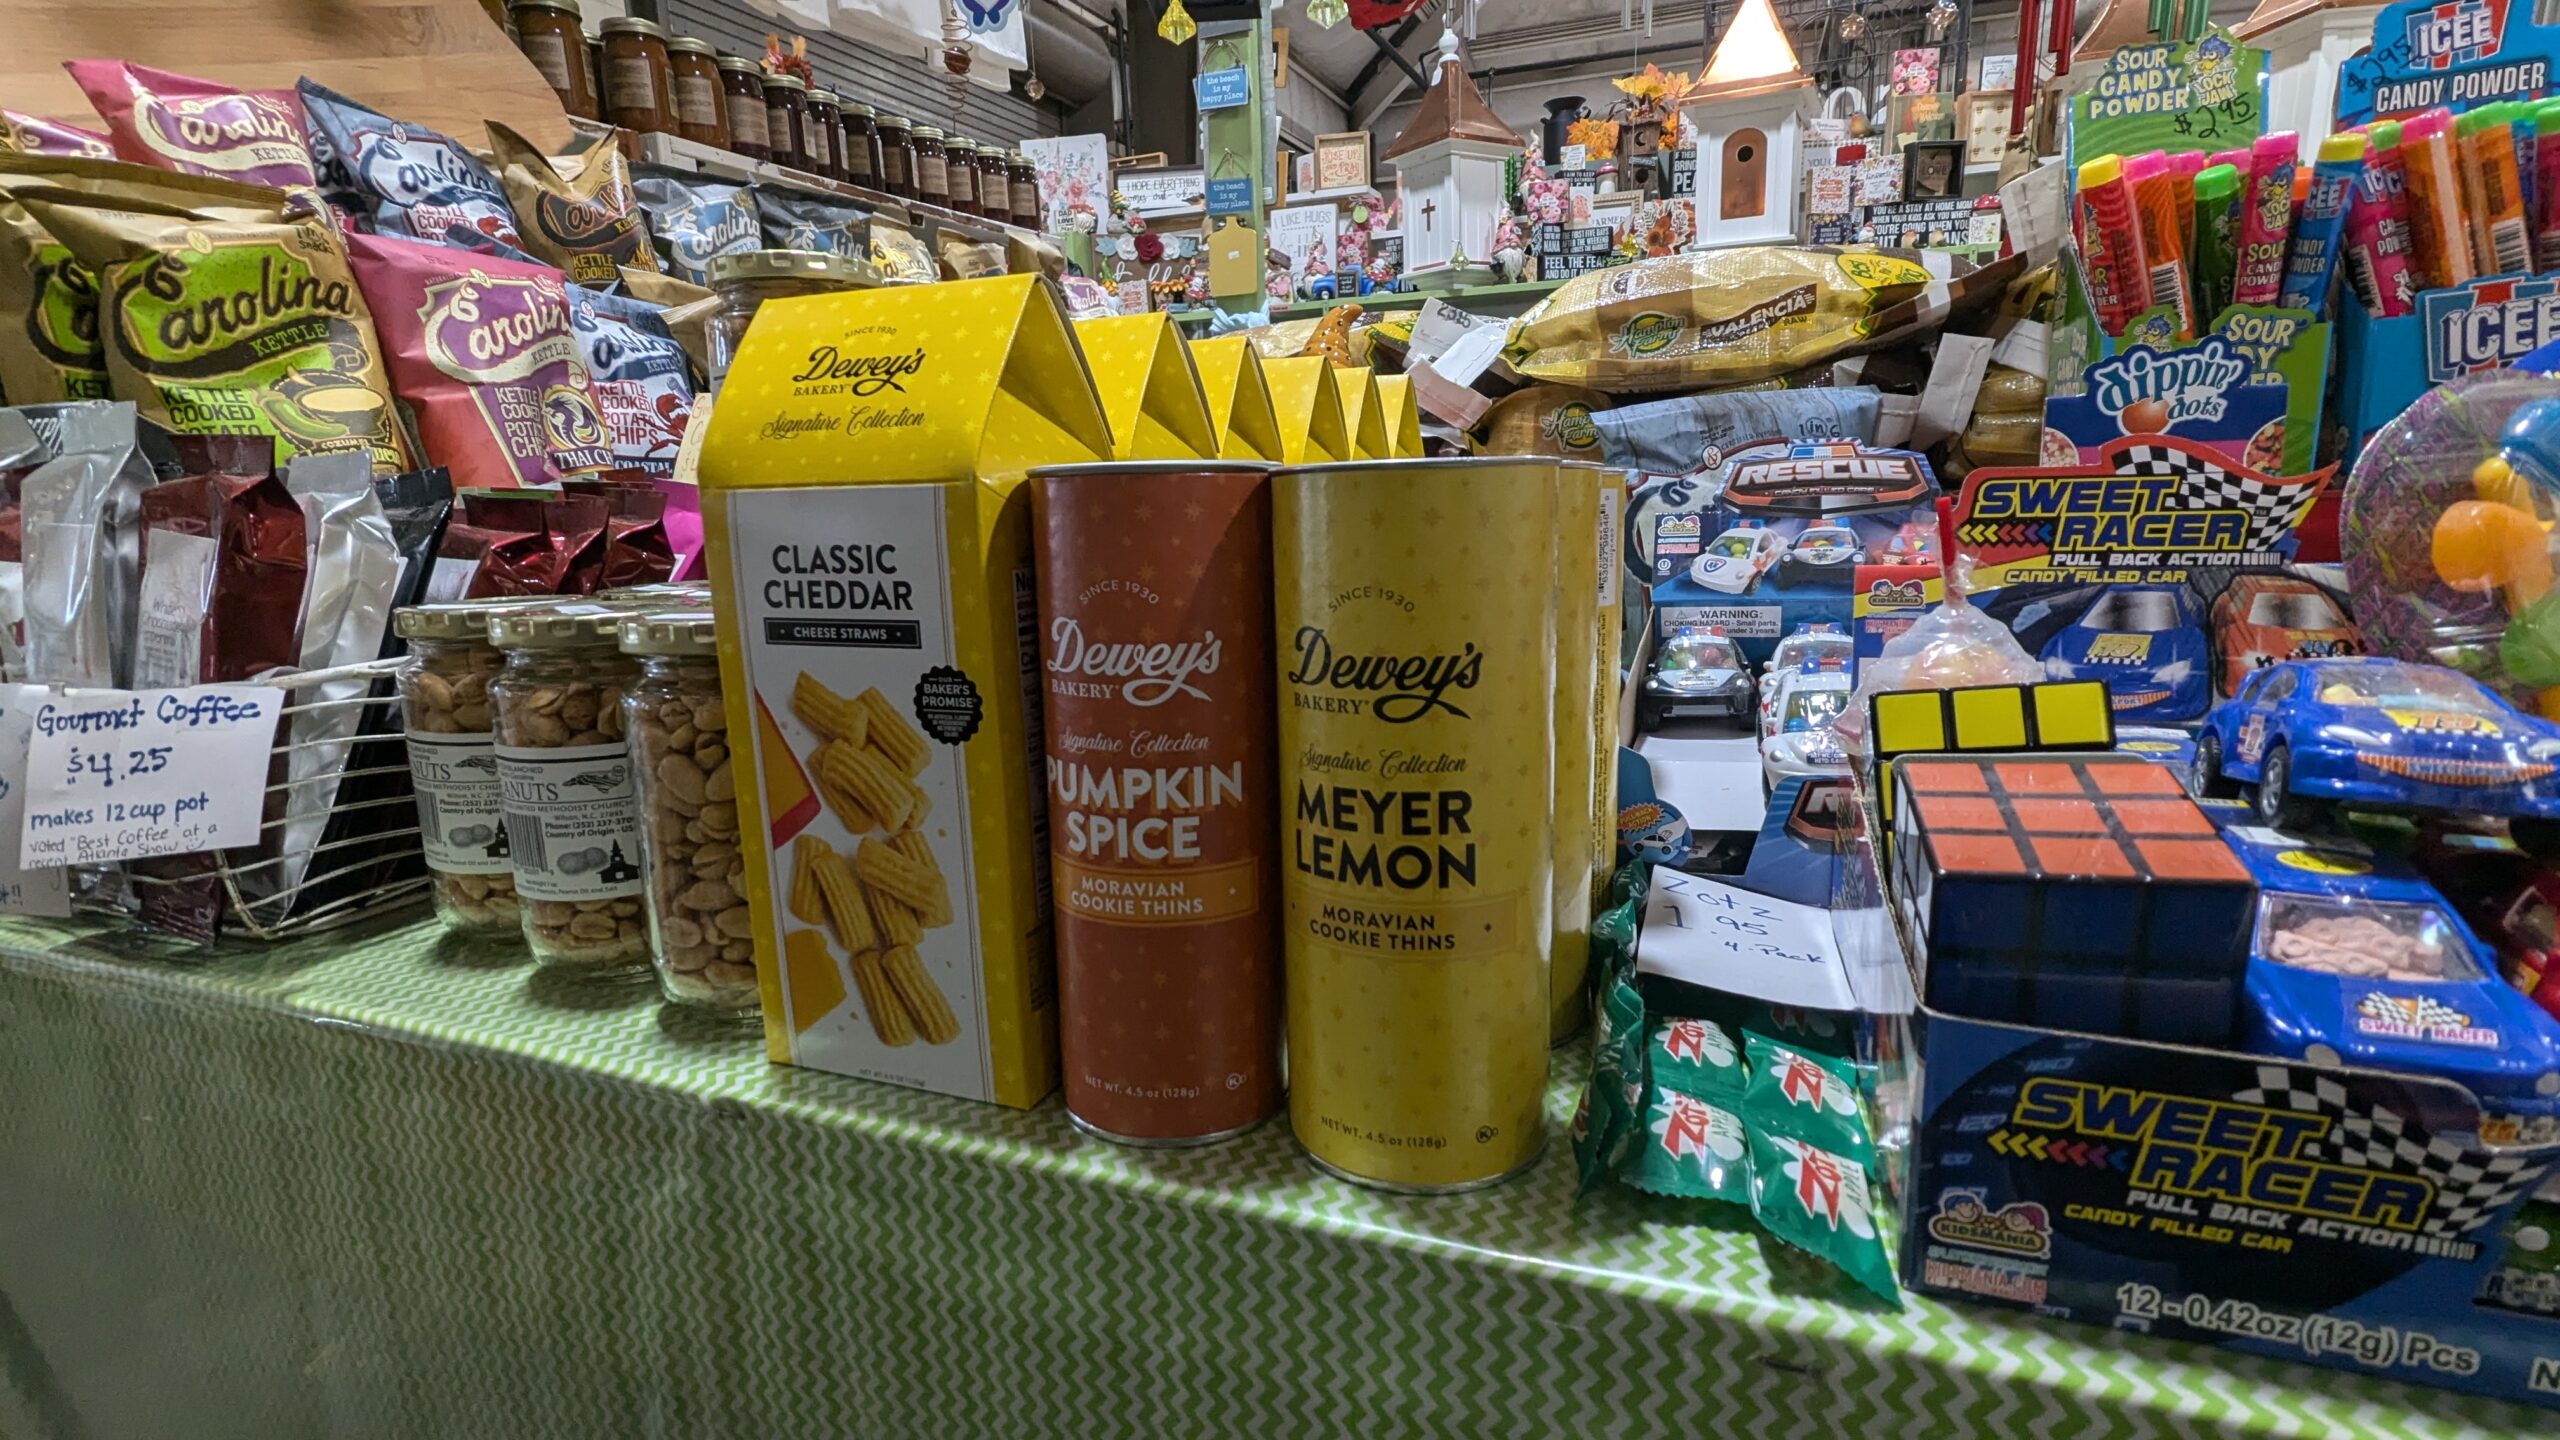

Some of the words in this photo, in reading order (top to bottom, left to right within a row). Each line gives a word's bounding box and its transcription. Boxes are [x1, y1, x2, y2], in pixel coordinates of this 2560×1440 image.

[2412, 8, 2493, 59] ICEE
[2116, 49, 2168, 72] SOUR
[1219, 74, 1240, 83] beach
[2101, 68, 2182, 97] CANDY
[2199, 70, 2235, 94] LOCK
[2376, 79, 2444, 113] CANDY
[2453, 62, 2547, 101] POWDER
[2091, 90, 2190, 119] POWDER
[2200, 88, 2234, 106] JAW
[2174, 92, 2257, 138] $2.95
[1131, 179, 1150, 191] HOPE
[1280, 213, 1301, 228] LIKE
[1304, 211, 1331, 224] HUGS
[1872, 214, 1890, 224] WHEN
[1908, 213, 1921, 222] KIDS
[1923, 212, 1936, 221] ASK
[1937, 212, 1950, 220] YOU
[1905, 204, 1923, 213] STAY
[1924, 203, 1934, 212] AT
[1935, 201, 1955, 211] HOME
[1956, 200, 1973, 210] MOM
[672, 207, 761, 262] Carolina
[573, 254, 614, 269] KETTLE
[575, 267, 617, 282] COOKED
[1545, 256, 1565, 269] FEEL
[1568, 256, 1584, 268] THE
[1545, 269, 1559, 279] AND
[1560, 269, 1570, 278] DO
[113, 252, 355, 372] Carolina
[1711, 290, 1807, 340] VALENCIA
[1783, 316, 1808, 328] RAW
[249, 323, 331, 357] KETTLE
[844, 327, 874, 338] SINCE
[876, 325, 897, 336] 1930
[1608, 316, 1686, 355] Hampton
[2226, 313, 2296, 346] SOUR
[531, 343, 571, 366] KETTLE
[1631, 328, 1681, 358] Farms
[793, 346, 926, 397] Dewey's
[162, 386, 248, 406] KETTLE
[495, 386, 539, 405] KETTLE
[599, 382, 647, 397] KETTLE
[793, 384, 848, 397] BAKERY
[169, 404, 256, 426] COOKED
[601, 396, 652, 411] COOKED
[2167, 396, 2222, 420] dots
[603, 413, 655, 428] POTATO
[761, 411, 842, 441] Signature
[846, 406, 926, 437] Collection
[606, 428, 660, 446] CHIPS
[557, 450, 594, 470] THAI
[614, 457, 673, 475] COASTAL
[1736, 459, 1912, 487] RESCUE
[1974, 477, 2180, 518] SWEET
[2053, 510, 2251, 552] RACER
[773, 544, 898, 575] CLASSIC
[2053, 553, 2105, 567] PULL
[2108, 552, 2161, 566] BACK
[2165, 551, 2242, 566] ACTION
[2004, 569, 2069, 584] CANDY
[2074, 569, 2140, 584] FILLED
[2149, 569, 2187, 584] CAR
[764, 580, 914, 611] CHEDDAR
[1079, 580, 1120, 604] SINCE
[1125, 580, 1160, 605] 1930
[1327, 586, 1374, 614] SINCE
[1377, 586, 1416, 615] 1930
[1699, 619, 1731, 627] HAZARD
[1736, 619, 1755, 627] Small
[1756, 619, 1779, 629] parts.
[1700, 610, 1763, 620] WARNING:
[793, 627, 837, 640] CHEESE
[840, 627, 887, 641] STRAWS
[1726, 627, 1748, 635] under
[1755, 628, 1777, 637] years.
[1047, 617, 1222, 707] Dewey's
[1290, 626, 1485, 724] Dewey's
[922, 696, 974, 708] PROMISE
[923, 684, 970, 695] BAKER'S
[1051, 681, 1115, 700] BAKERY
[36, 698, 146, 737] Gourmet
[157, 695, 262, 726] Coffee
[1294, 692, 1362, 715] BAKERY
[1058, 729, 1123, 755] Signature
[1129, 730, 1211, 755] Collection
[66, 747, 174, 787] $4.25
[1299, 742, 1373, 777] Signature
[1378, 750, 1468, 778] Collection
[1047, 756, 1245, 811] PUMPKIN
[31, 808, 94, 830] makes
[106, 803, 125, 822] 12
[129, 803, 166, 825] cup
[175, 792, 210, 823] pot
[1297, 779, 1474, 836] MEYER
[29, 838, 65, 854] voted
[182, 826, 202, 838] at
[207, 823, 219, 834] a
[545, 829, 575, 840] Country
[576, 828, 586, 838] of
[587, 826, 615, 838] Origin
[1066, 812, 1202, 861] SPICE
[137, 841, 179, 857] Show
[1297, 831, 1477, 890] LEMON
[1081, 875, 1186, 899] MORAVIAN
[1070, 890, 1137, 916] COOKIE
[1142, 894, 1205, 915] THINS
[1321, 903, 1437, 931] MORAVIAN
[1309, 916, 1382, 949] COOKIE
[1386, 928, 1457, 952] THINS
[2357, 1016, 2422, 1038] SWEET
[2432, 1021, 2499, 1048] RACER
[1084, 1073, 1103, 1090] NET
[1105, 1079, 1122, 1094] WT.
[1125, 1084, 1145, 1099] 4.5
[1146, 1088, 1160, 1099] oz
[1162, 1085, 1201, 1100] (128g)
[2013, 1076, 2332, 1158] SWEET
[1320, 1114, 1342, 1131] NET
[1344, 1120, 1364, 1138] WT.
[1366, 1131, 1387, 1145] 4.5
[1389, 1134, 1404, 1148] oz
[1405, 1134, 1448, 1150] (128g)
[1841, 1161, 1865, 1208] APPLE
[2130, 1141, 2441, 1231] RACER
[2063, 1202, 2141, 1231] CANDY
[2149, 1216, 2233, 1248] FILLED
[2239, 1229, 2294, 1255] CAR
[2126, 1188, 2205, 1219] PULL
[2210, 1202, 2291, 1233] BACK
[2299, 1215, 2418, 1254] ACTION
[1940, 1223, 2037, 1248] KIDSMANIA
[2116, 1282, 2302, 1346] 12-0.42oz
[2303, 1314, 2399, 1367] (12g)
[2405, 1332, 2481, 1375] Pcs
